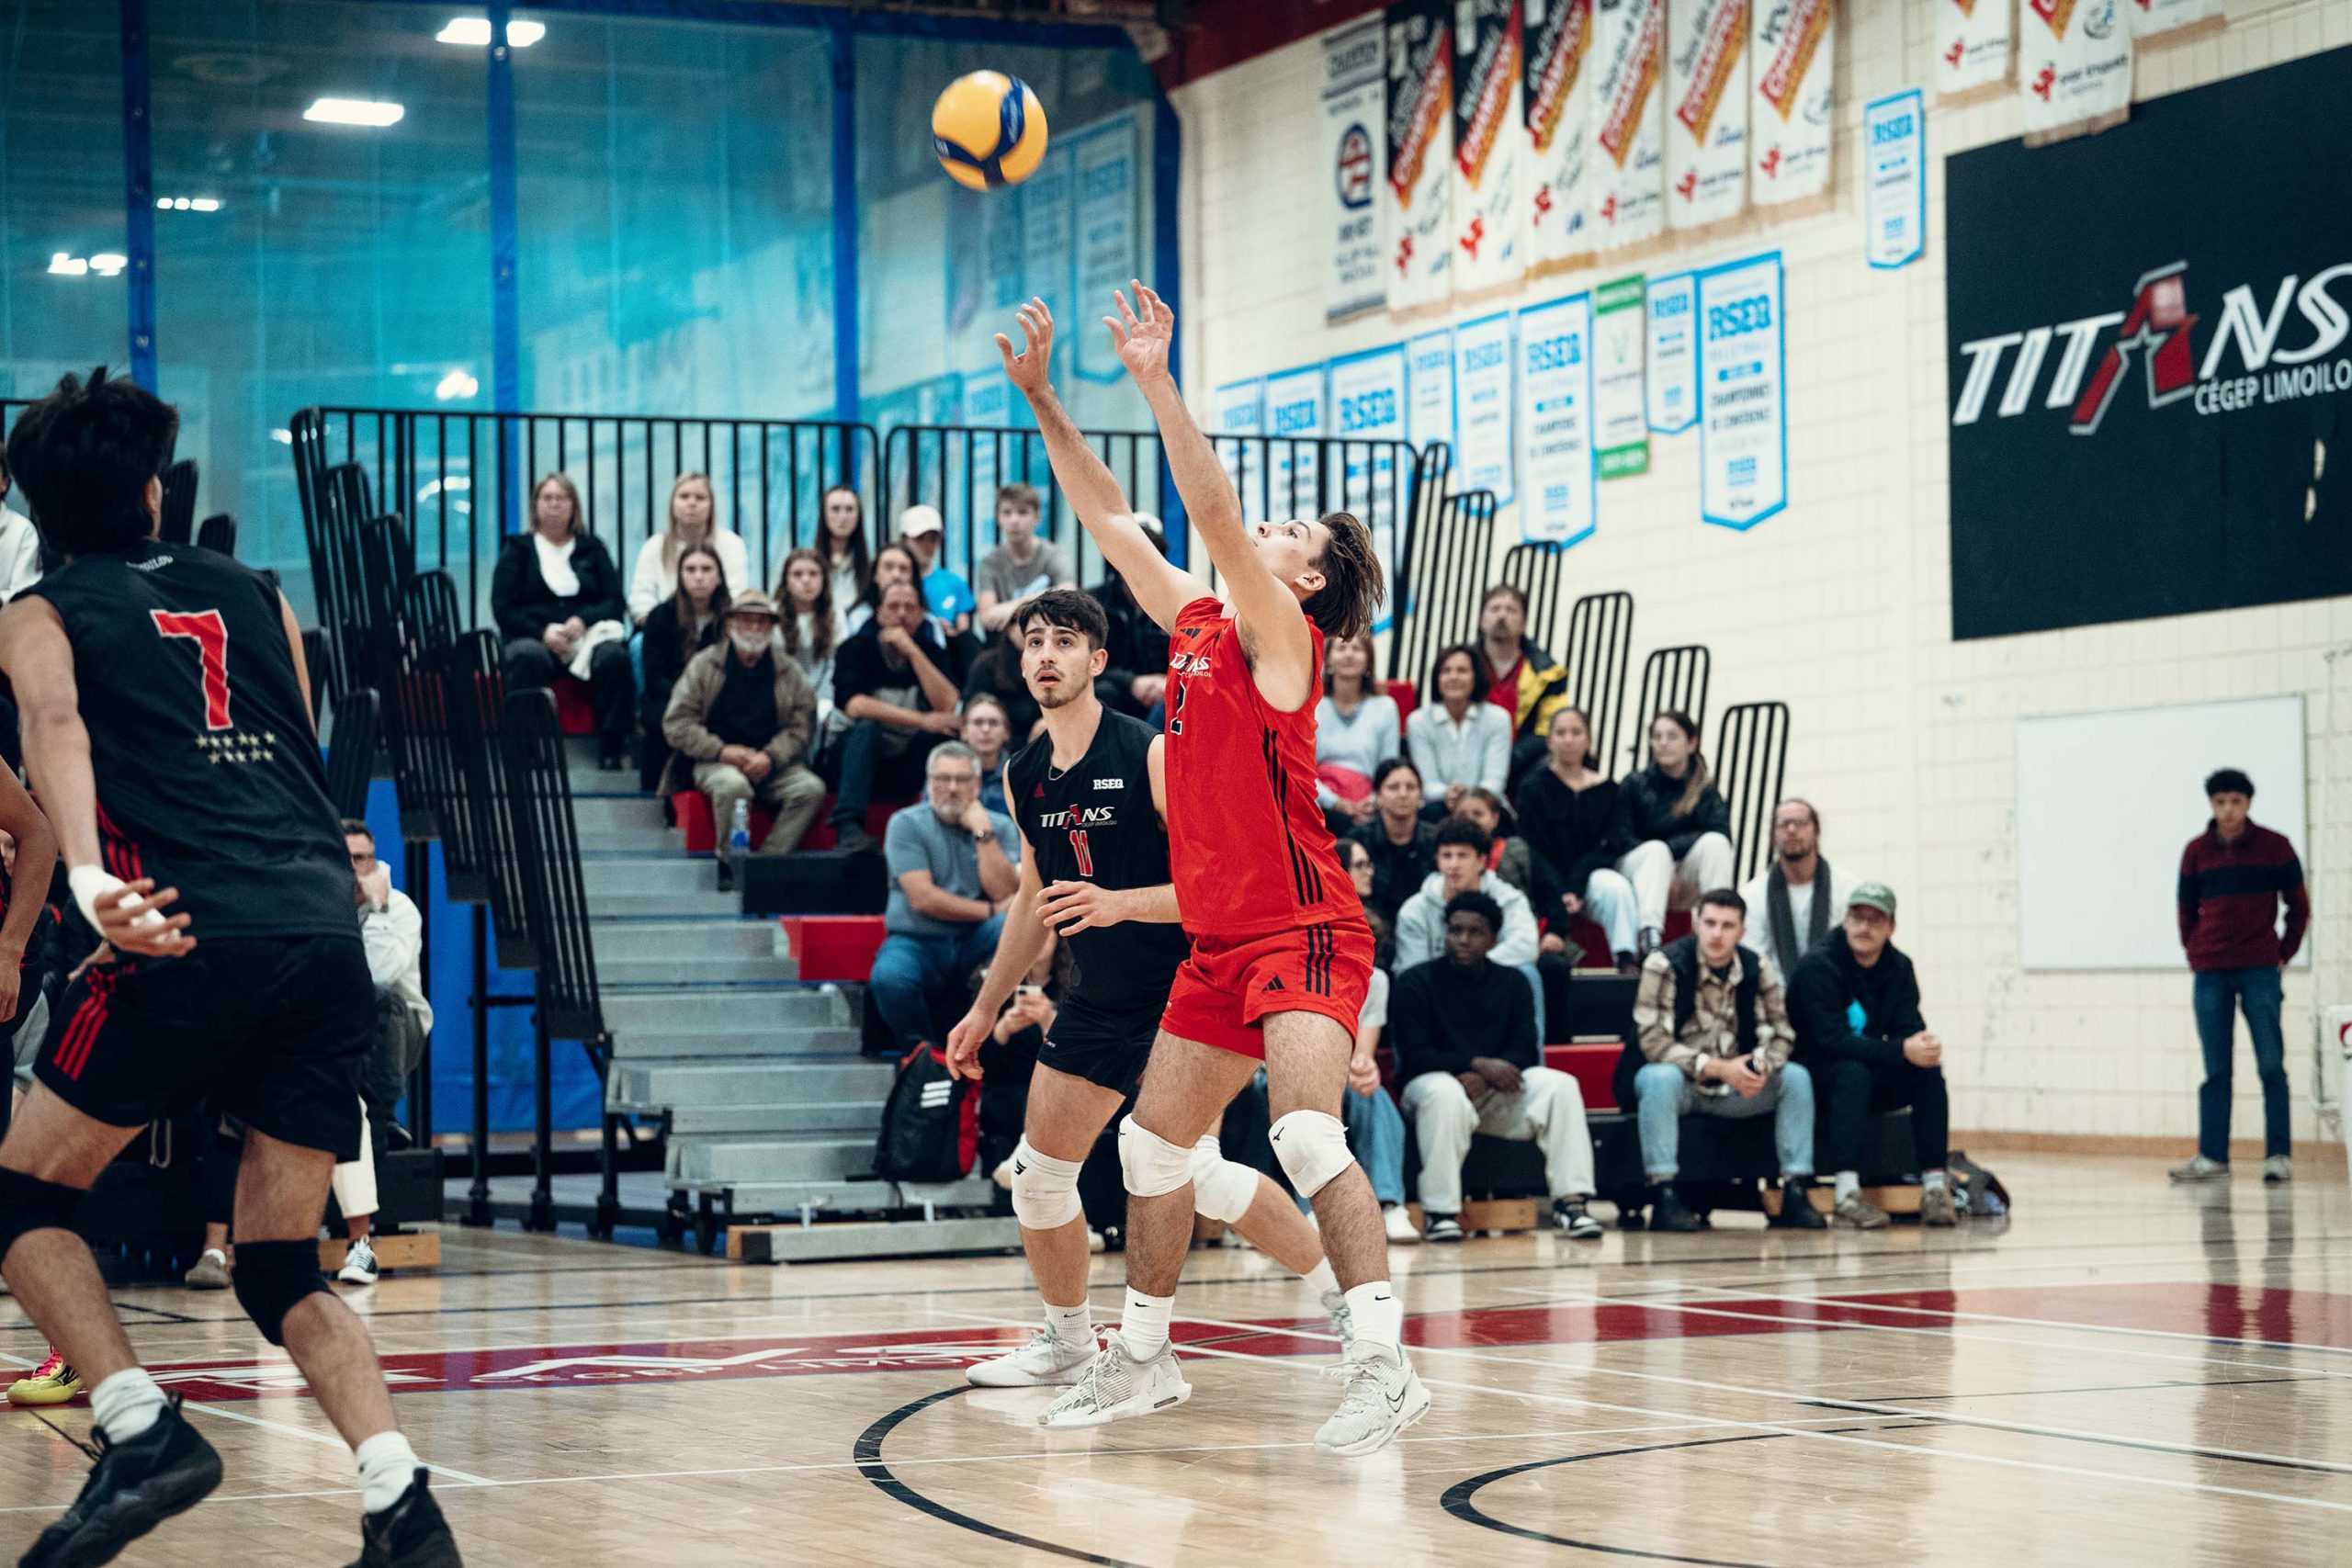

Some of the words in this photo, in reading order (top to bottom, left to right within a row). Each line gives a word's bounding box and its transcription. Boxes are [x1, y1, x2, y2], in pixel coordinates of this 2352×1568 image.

[1952, 260, 2352, 434] TITANS
[2195, 376, 2260, 415] CÉGEP
[149, 608, 233, 731] 7
[1092, 778, 1125, 790] RSEQ
[1040, 804, 1115, 829] TITANS
[1069, 829, 1093, 876] 11
